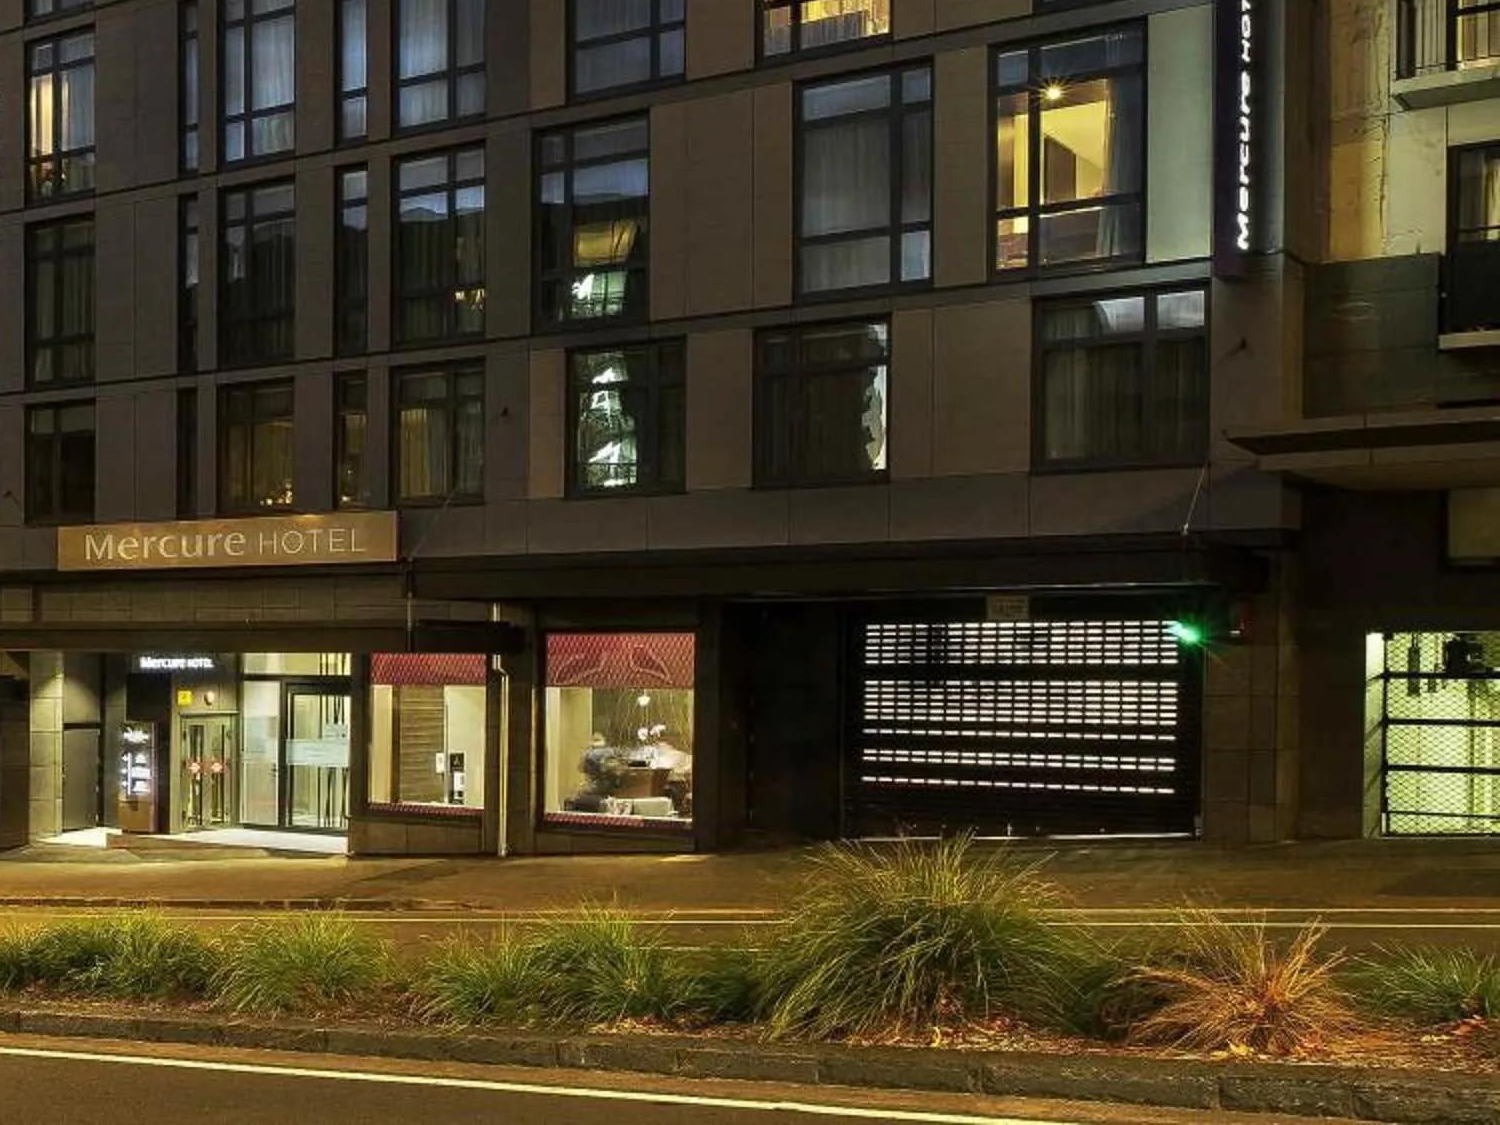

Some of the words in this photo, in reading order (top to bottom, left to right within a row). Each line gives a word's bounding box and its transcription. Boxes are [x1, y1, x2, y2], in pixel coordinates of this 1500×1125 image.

[1236, 70, 1251, 250] Mercure
[84, 530, 247, 561] Mercure
[258, 527, 367, 556] HOTEL
[140, 656, 186, 669] Mercure
